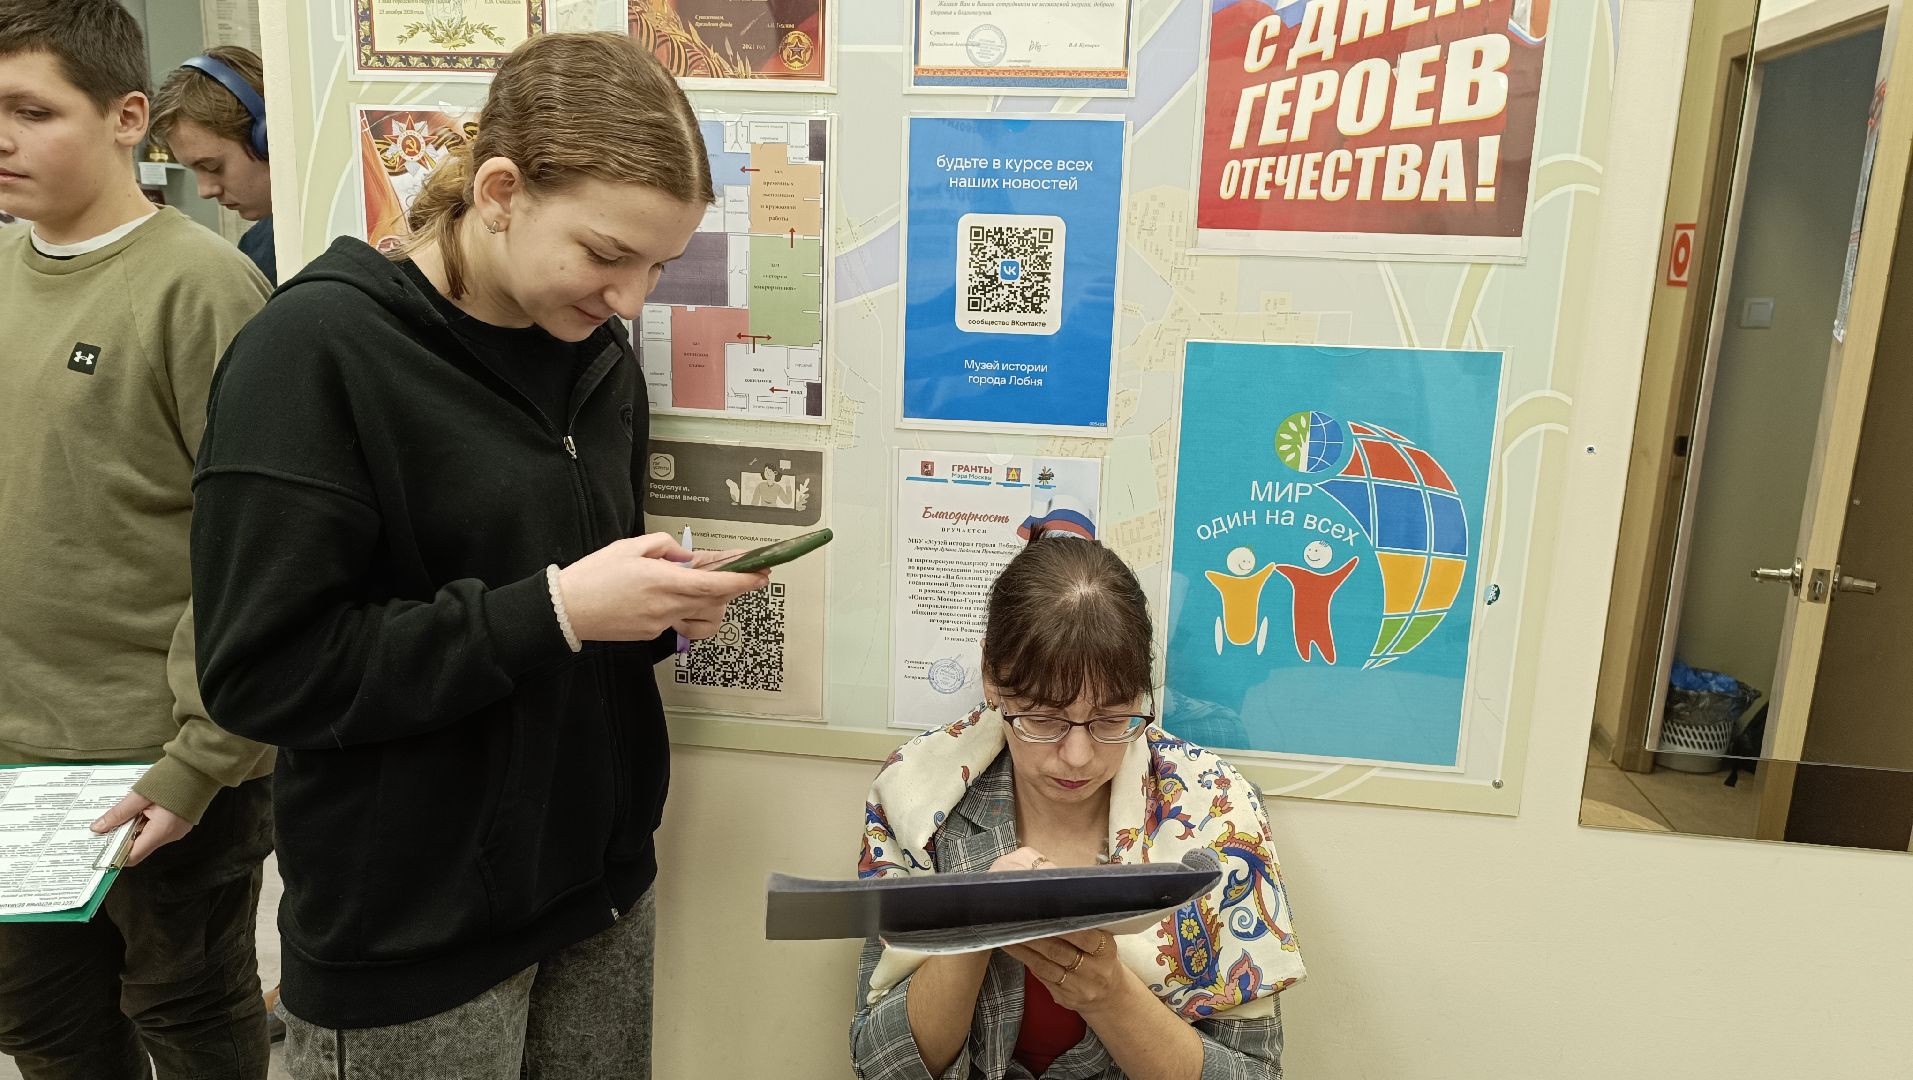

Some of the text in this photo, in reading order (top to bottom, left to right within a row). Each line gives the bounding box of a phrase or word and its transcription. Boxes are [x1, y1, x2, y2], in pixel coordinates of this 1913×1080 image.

[1243, 14, 1281, 73] С
[1228, 33, 1512, 150] ГЕРОЕВ
[936, 154, 1094, 172] будьте в курсе всех
[1218, 134, 1502, 202] ОТЕЧЕСТВА!
[949, 176, 1078, 190] наших новостей
[964, 359, 1048, 374] Музей истории
[968, 376, 1043, 386] города Лобня
[952, 464, 992, 474] ГРАНТЫ
[650, 492, 680, 500] Решаем
[1250, 480, 1314, 504] МИР
[922, 506, 1010, 526] Благодарность
[1196, 508, 1360, 546] один на всех
